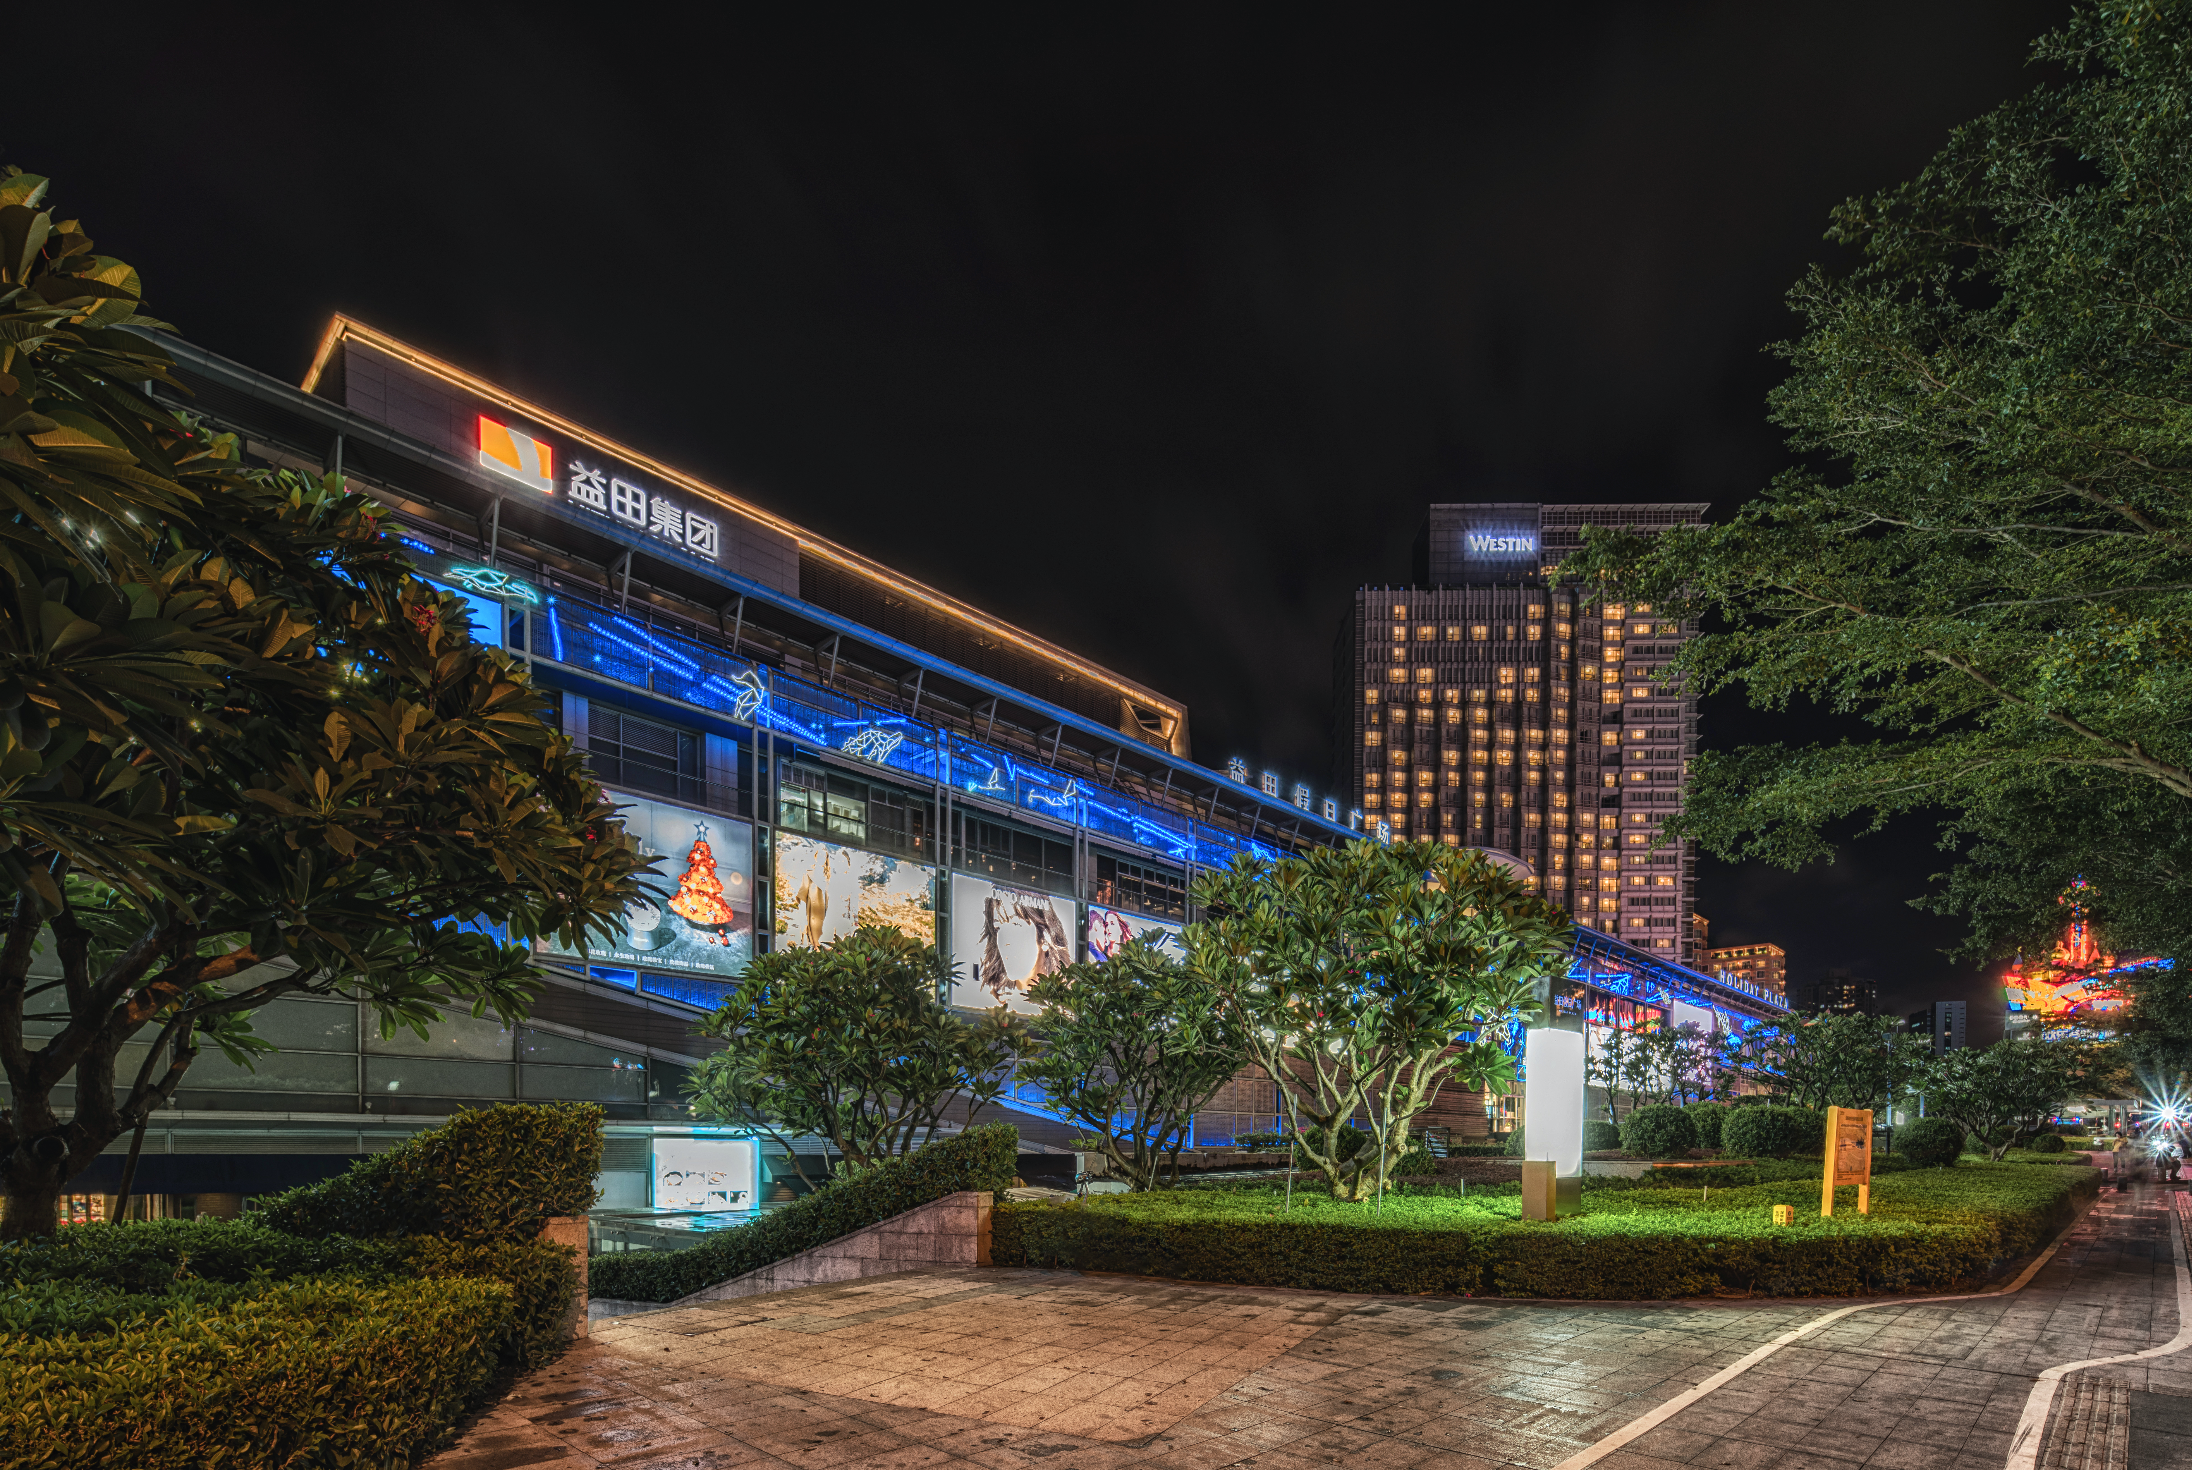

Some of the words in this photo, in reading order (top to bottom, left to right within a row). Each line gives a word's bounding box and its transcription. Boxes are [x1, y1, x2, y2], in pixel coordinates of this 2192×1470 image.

[567, 459, 720, 558] 益田集团
[1469, 534, 1534, 552] WESTIN
[1228, 756, 1391, 845] 益田假日广场
[1720, 969, 1760, 998] HOLIDAY
[1764, 988, 1789, 1010] PLAZA
